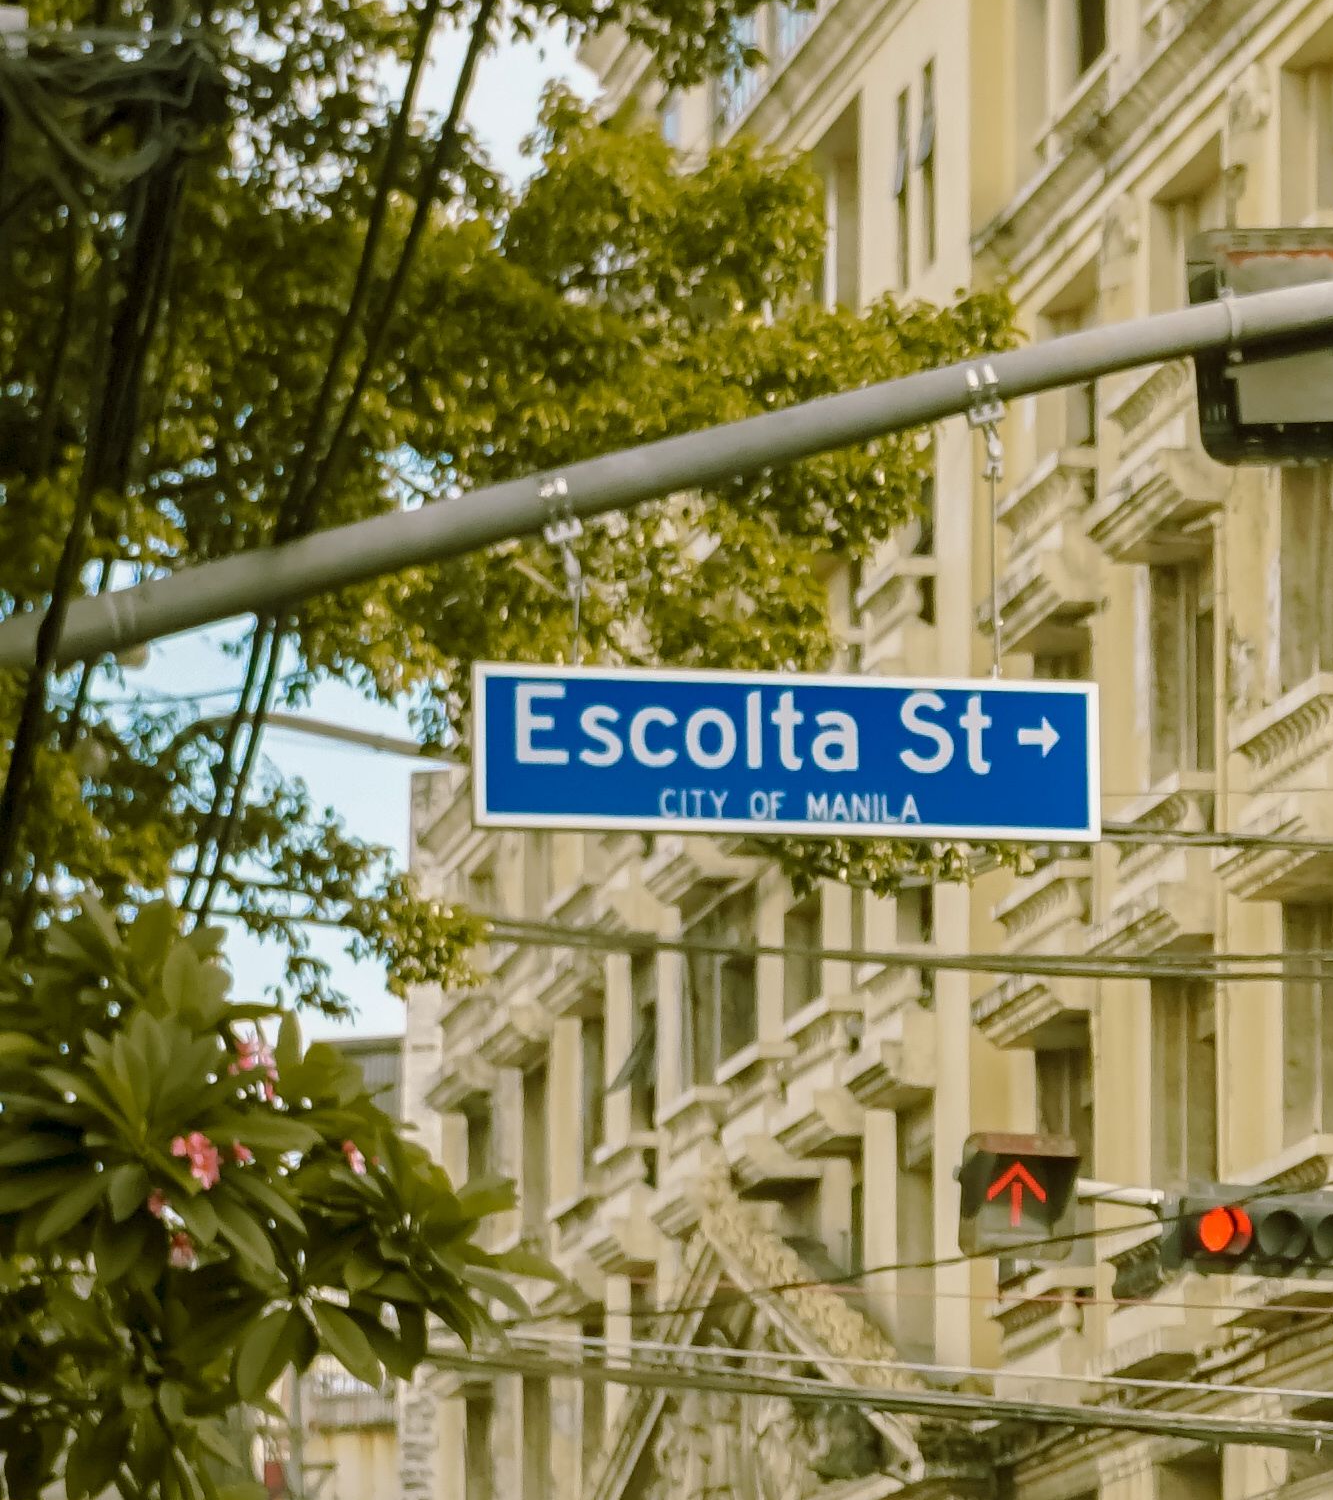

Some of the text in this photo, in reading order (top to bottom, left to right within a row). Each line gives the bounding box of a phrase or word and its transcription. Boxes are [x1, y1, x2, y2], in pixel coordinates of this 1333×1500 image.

[512, 680, 993, 775] Escolta St
[658, 788, 921, 824] CITY OF MANILA
